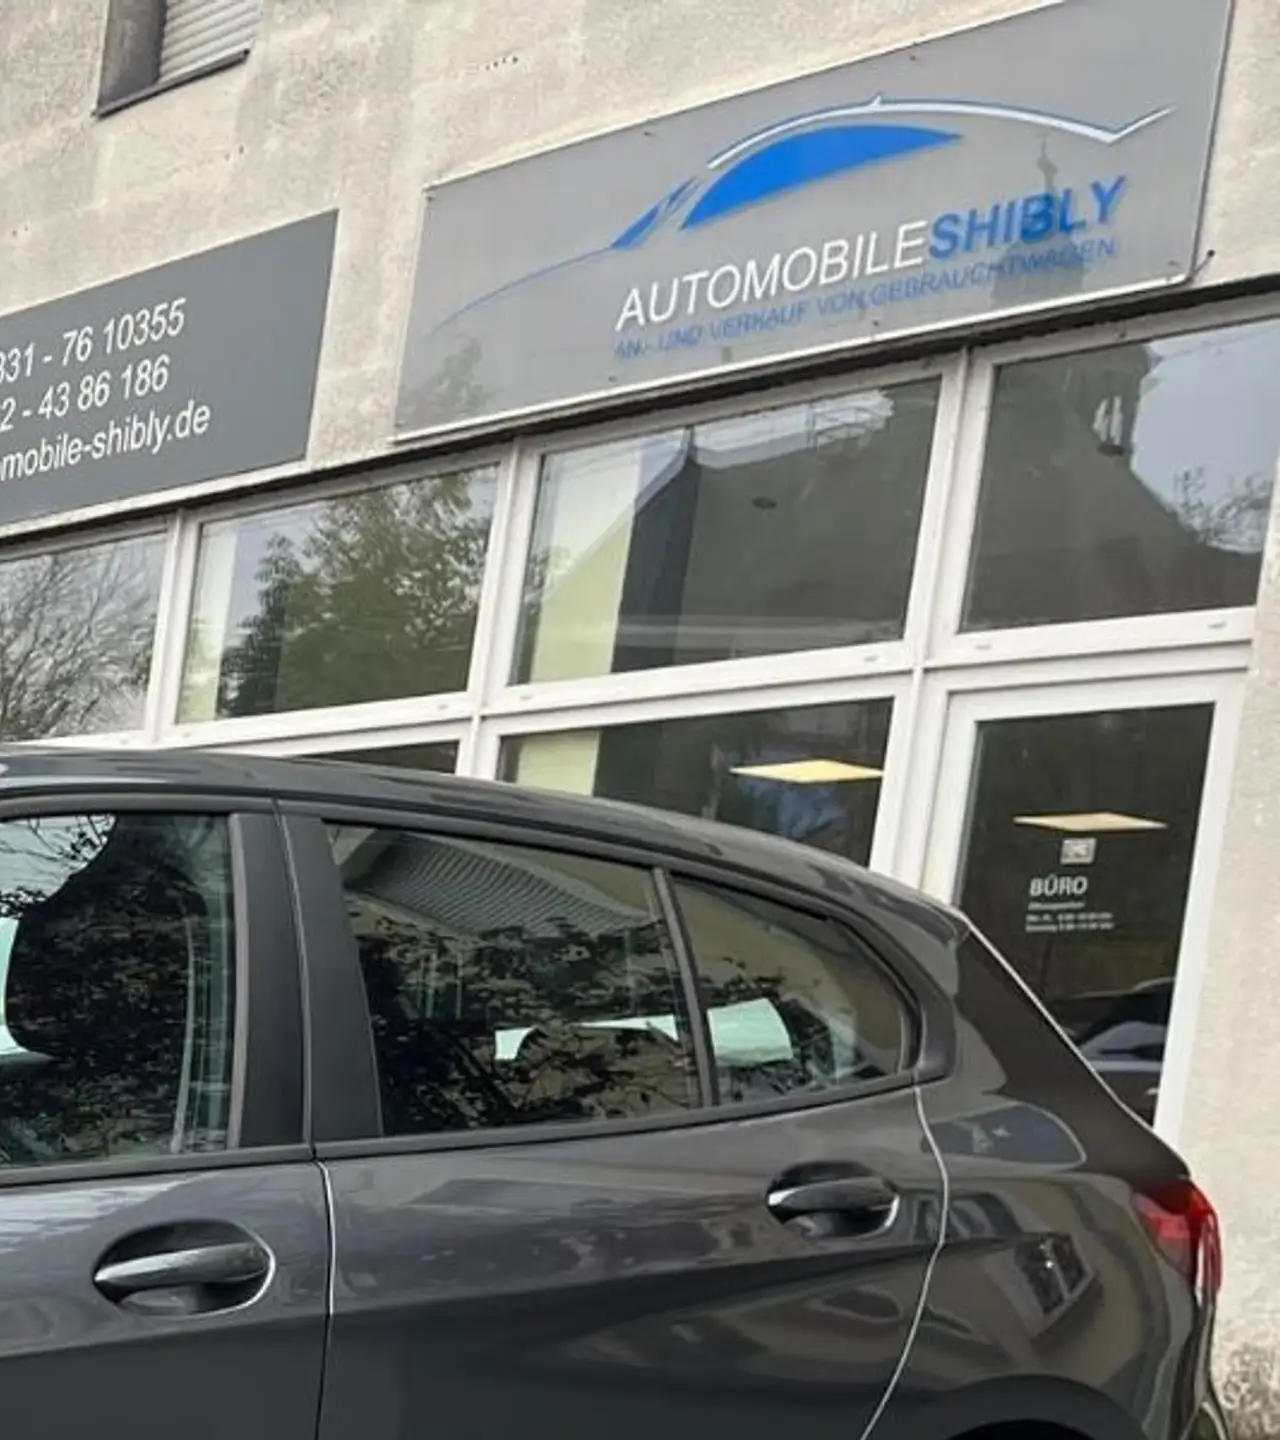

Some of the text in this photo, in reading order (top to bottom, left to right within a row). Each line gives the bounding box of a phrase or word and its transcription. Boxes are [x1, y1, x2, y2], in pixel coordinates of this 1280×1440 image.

[709, 300, 809, 339] VERKAUF
[816, 287, 866, 317] VON
[870, 236, 1117, 306] GEBRAUCHTWAGEN
[61, 326, 93, 367] 76
[102, 298, 187, 355] 10355
[37, 381, 71, 420] 43
[76, 369, 112, 412] 86
[120, 353, 171, 399] 186
[1029, 873, 1089, 897] BÜRO
